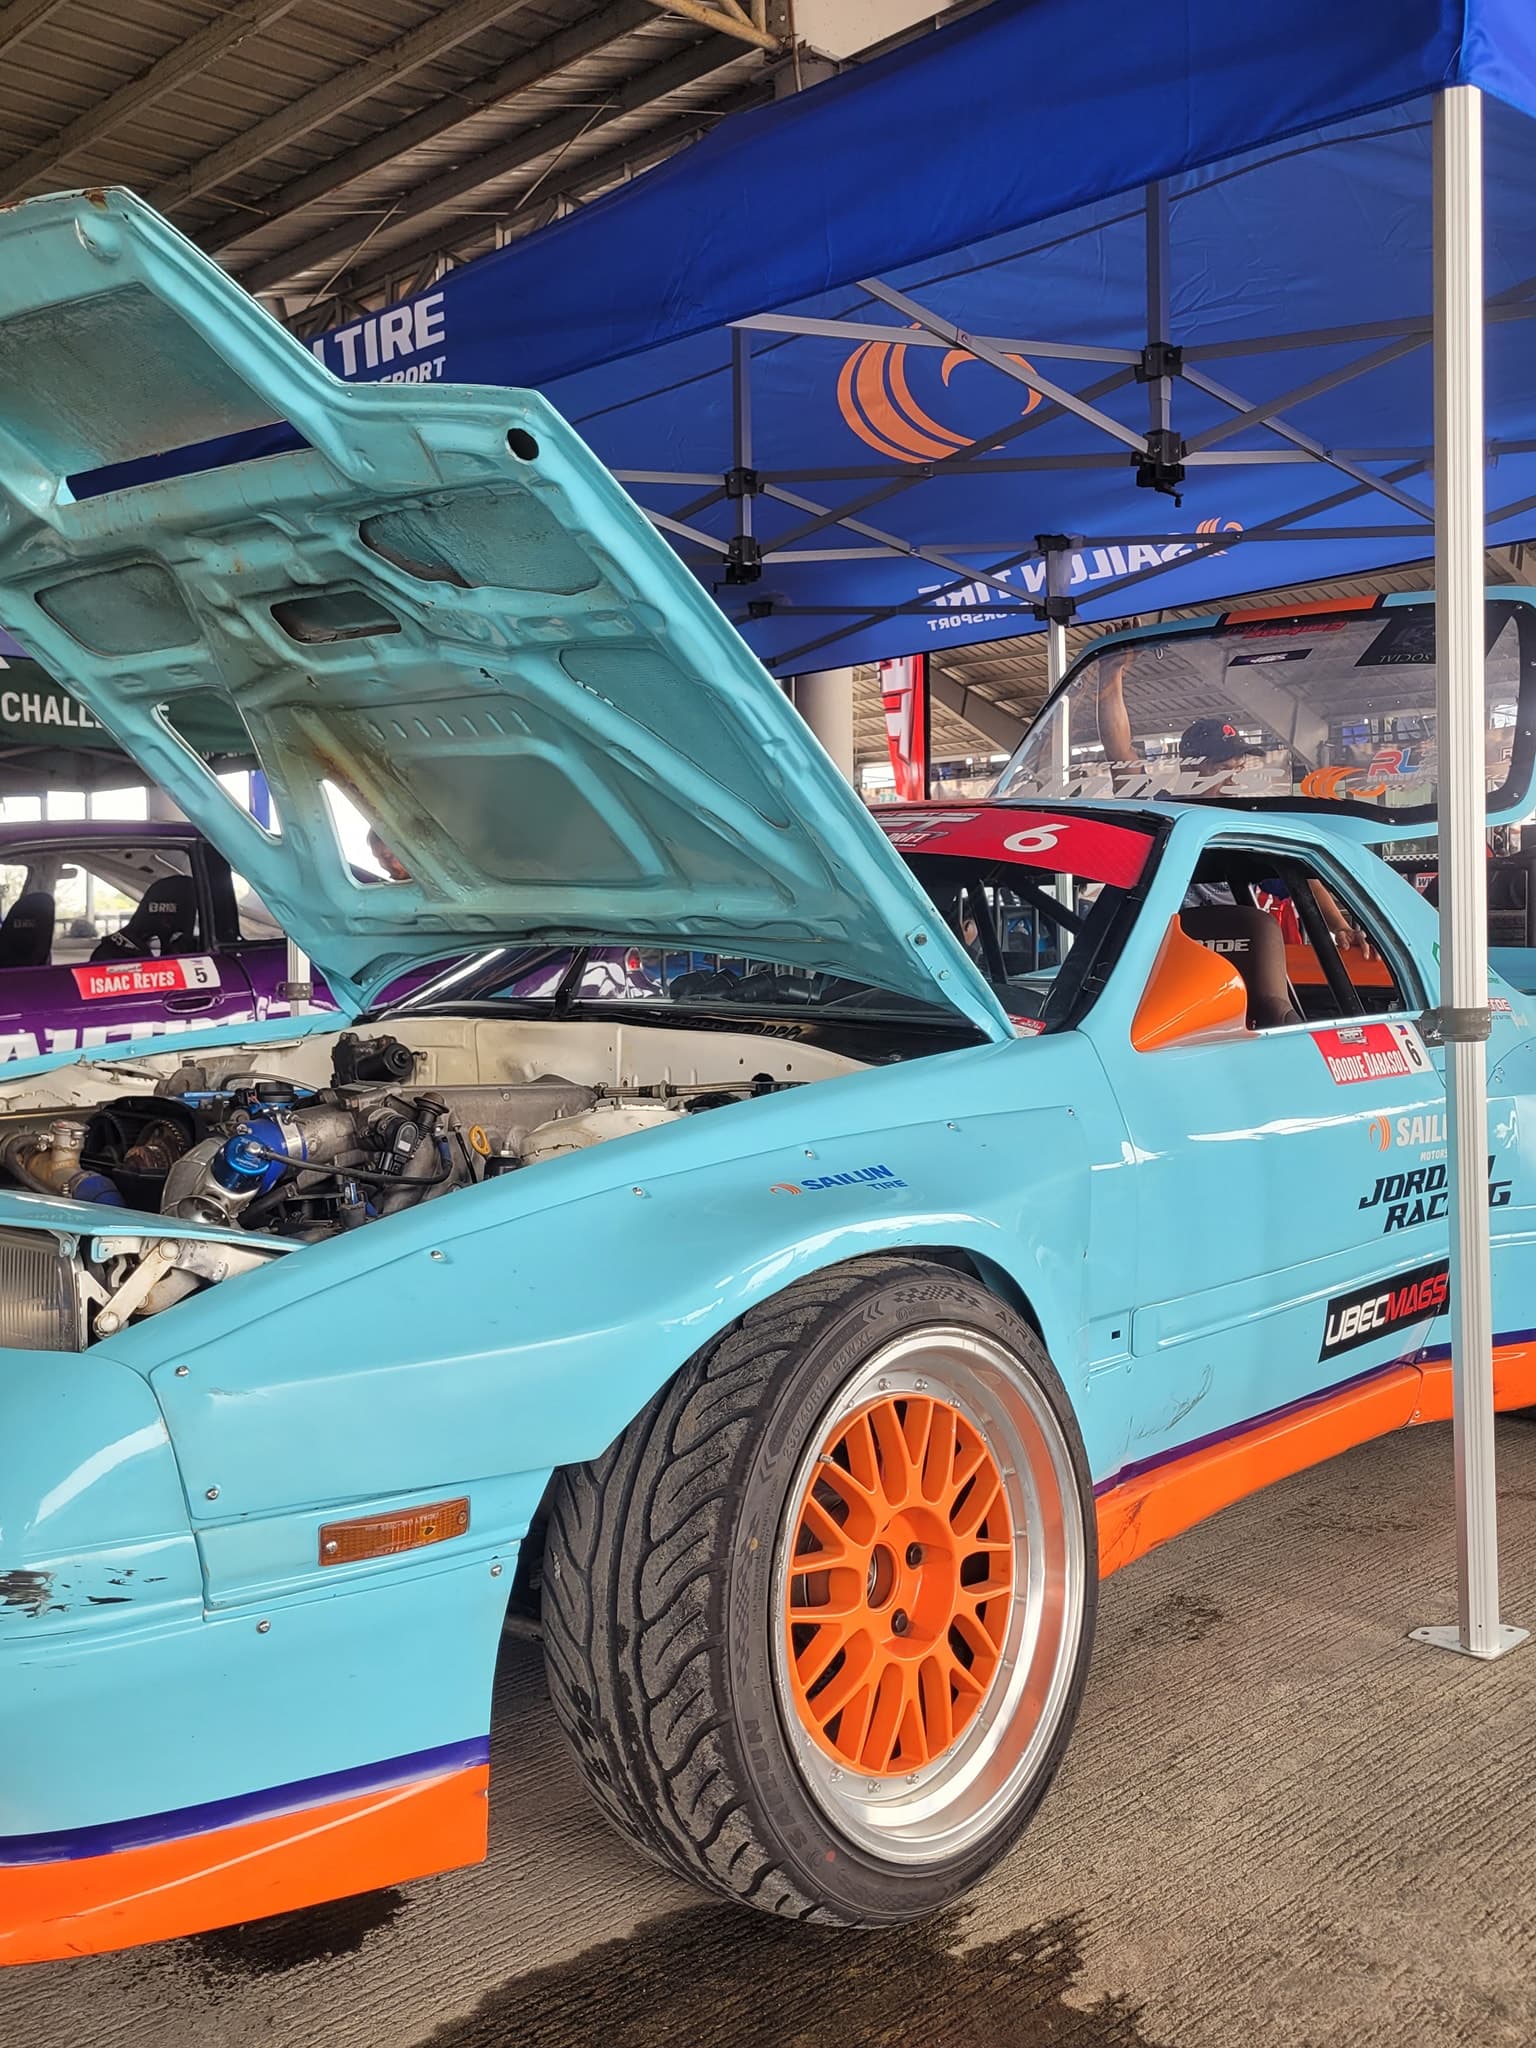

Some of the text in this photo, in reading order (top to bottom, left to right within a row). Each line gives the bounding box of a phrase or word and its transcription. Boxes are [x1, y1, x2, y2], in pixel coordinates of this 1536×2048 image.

[334, 292, 446, 377] TIRE
[1003, 823, 1070, 853] 6
[1196, 938, 1251, 953] IDE
[90, 967, 208, 994] ISAAC REYES 5
[1404, 1038, 1423, 1067] 6
[801, 1164, 895, 1191] SAILUN
[865, 1179, 909, 1191] TIRE
[1358, 1154, 1497, 1210] JORD
[1383, 1180, 1513, 1234] RACG
